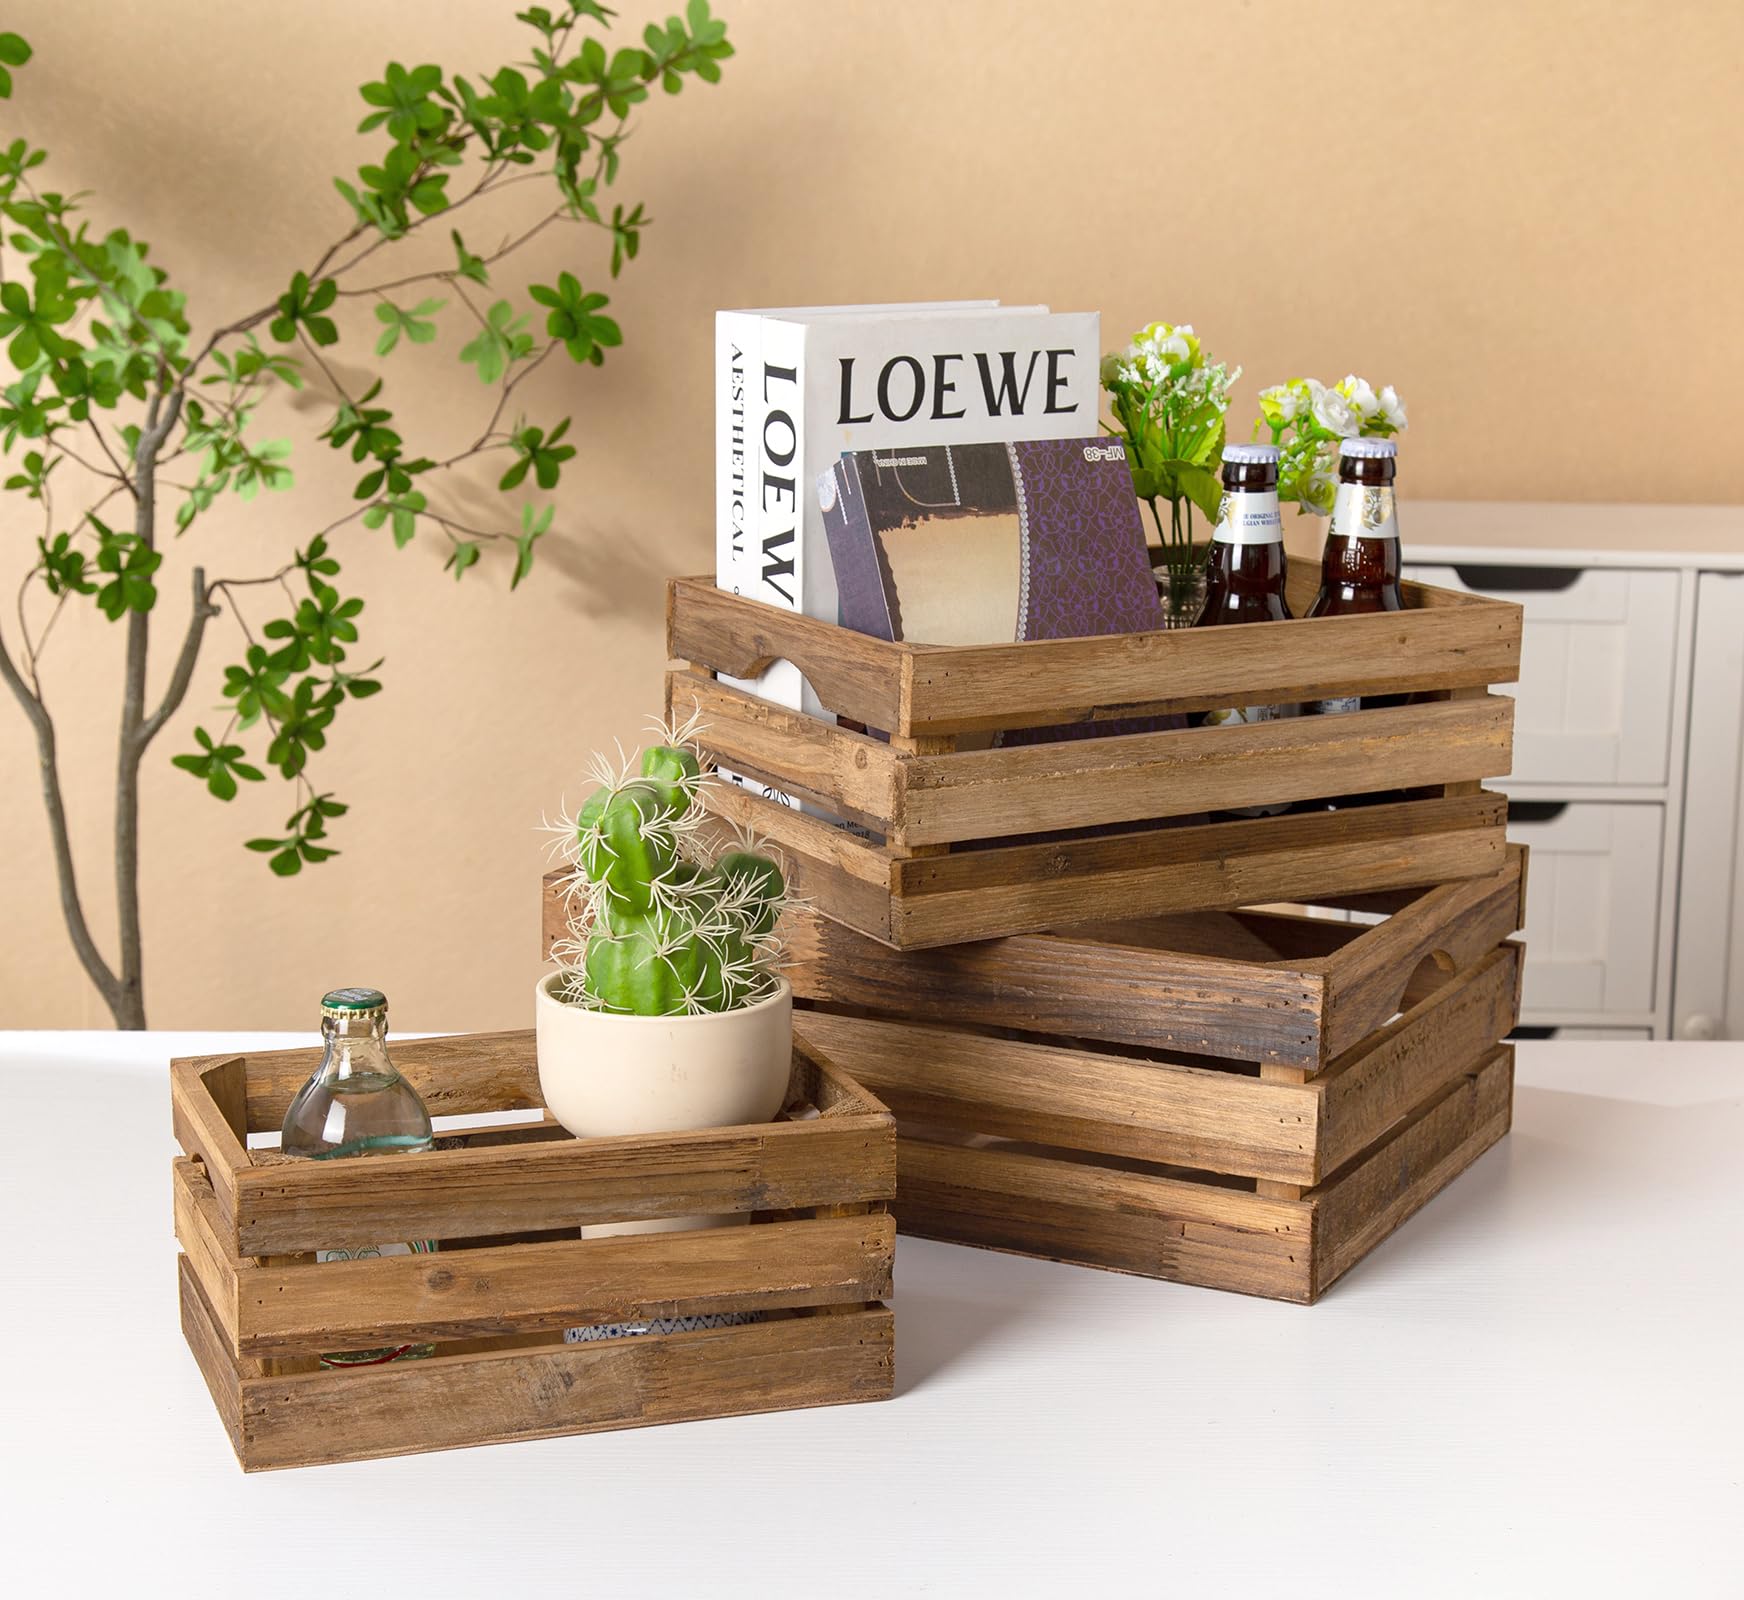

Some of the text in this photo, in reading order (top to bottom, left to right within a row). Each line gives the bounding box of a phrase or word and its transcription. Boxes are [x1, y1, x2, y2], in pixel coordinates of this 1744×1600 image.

[731, 342, 745, 562] AESTHETICAL
[836, 349, 1079, 425] LOEWE
[1083, 446, 1125, 462] MF-38
[761, 361, 797, 606] LOEW
